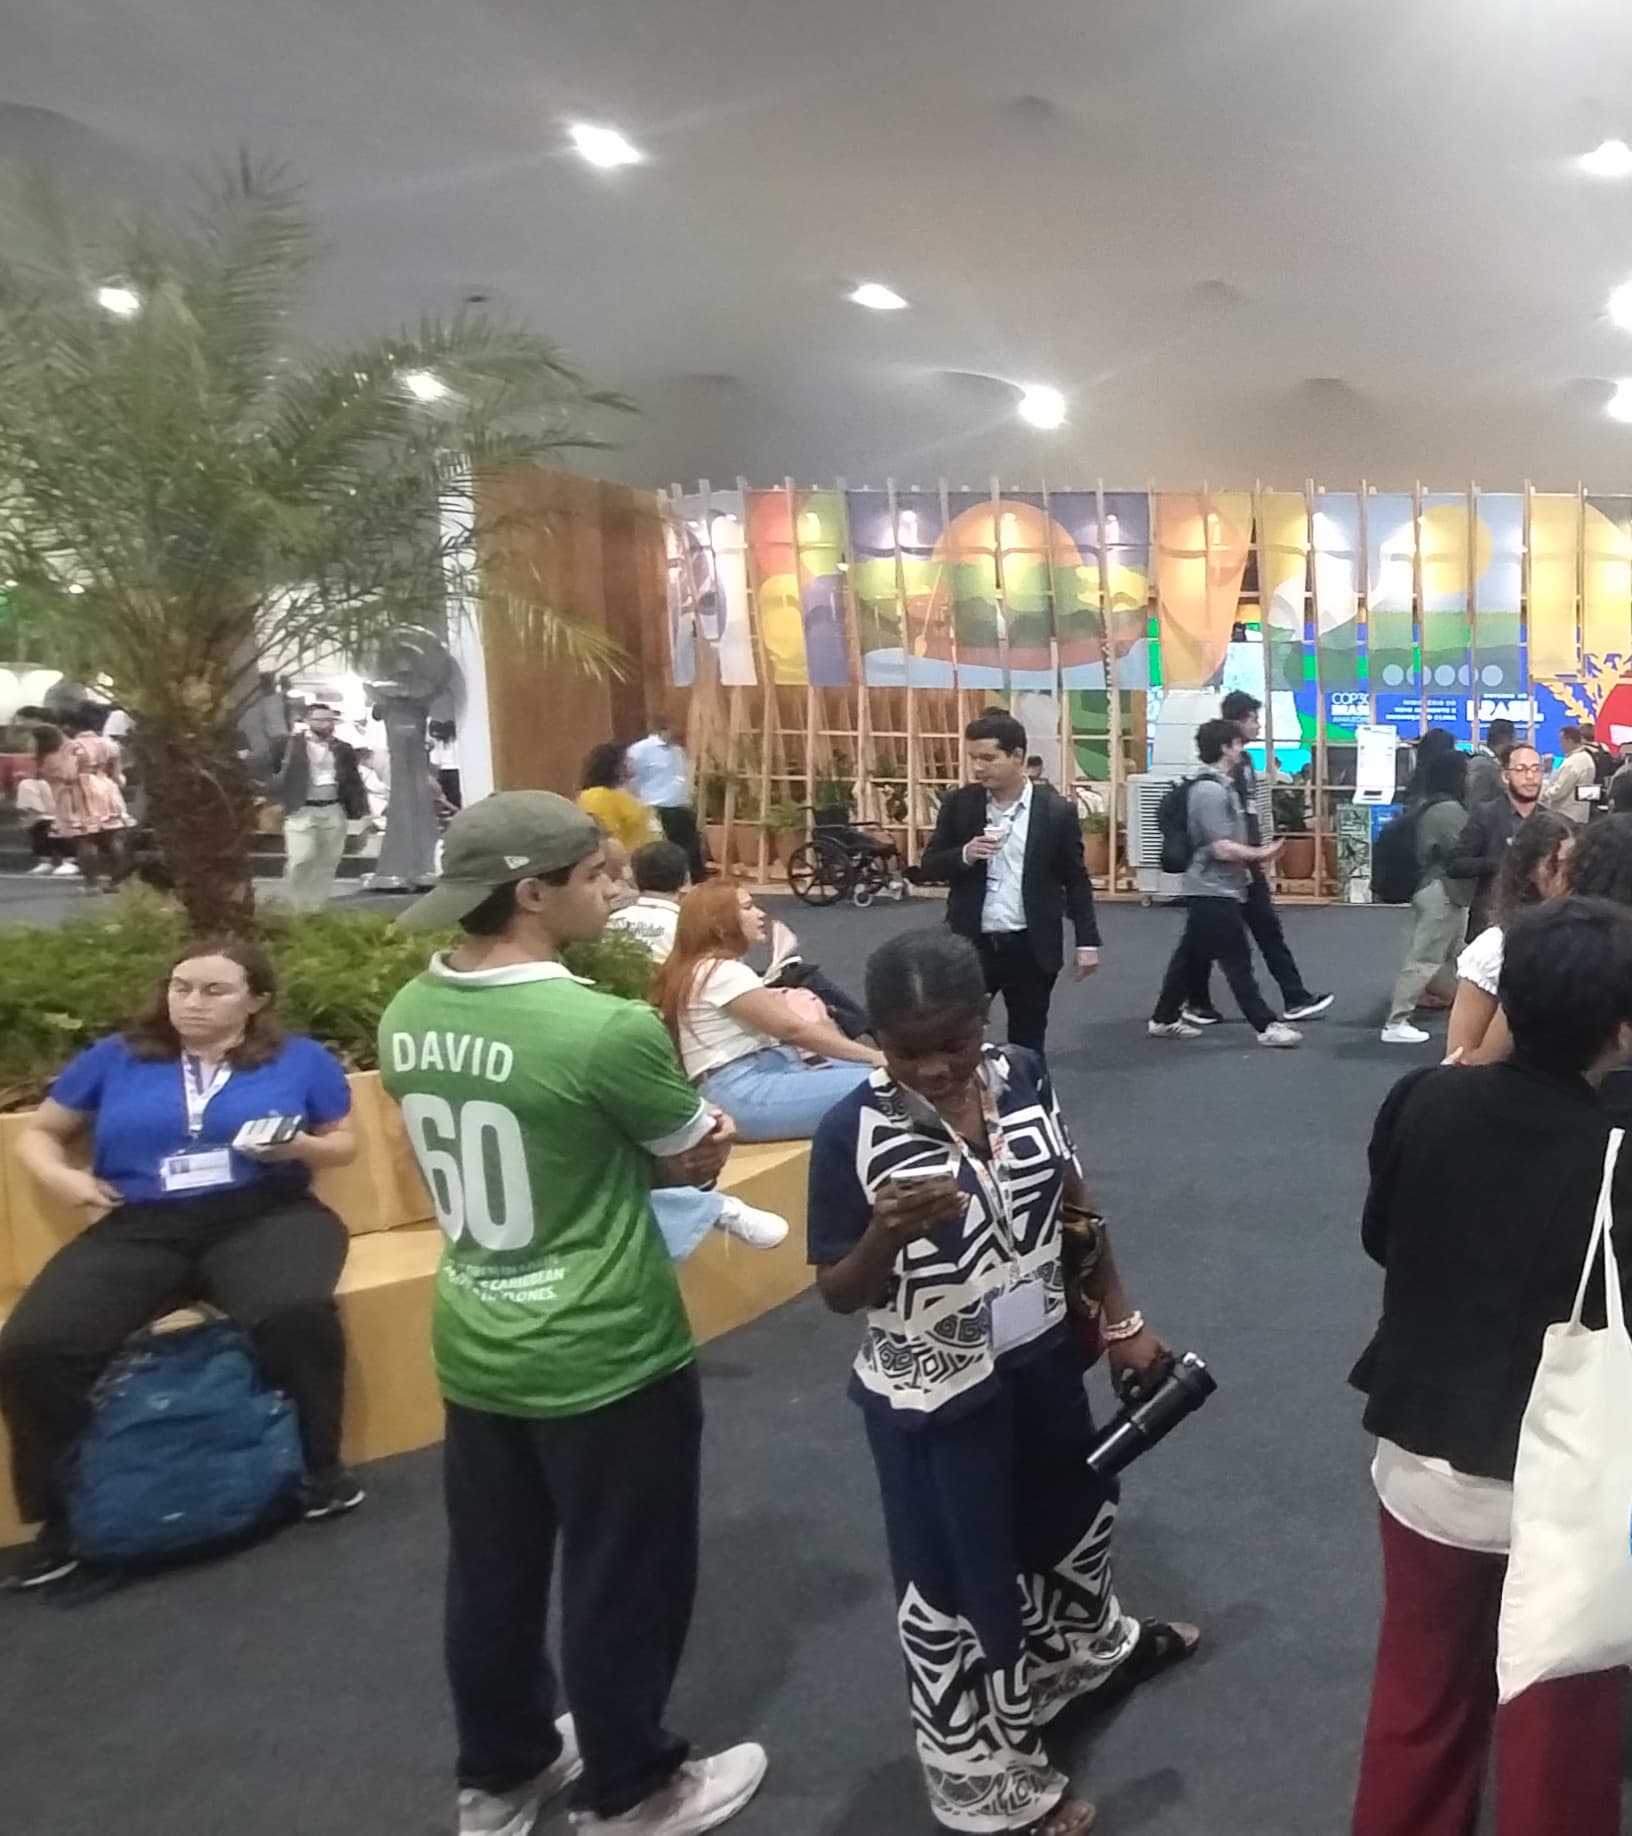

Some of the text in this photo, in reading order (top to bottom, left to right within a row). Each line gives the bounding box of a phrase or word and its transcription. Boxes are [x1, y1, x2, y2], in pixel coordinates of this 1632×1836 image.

[1466, 700, 1545, 721] BRASIL
[391, 1031, 514, 1083] DAVID
[400, 1092, 535, 1251] 60
[489, 1267, 566, 1291] CARIBBEAN
